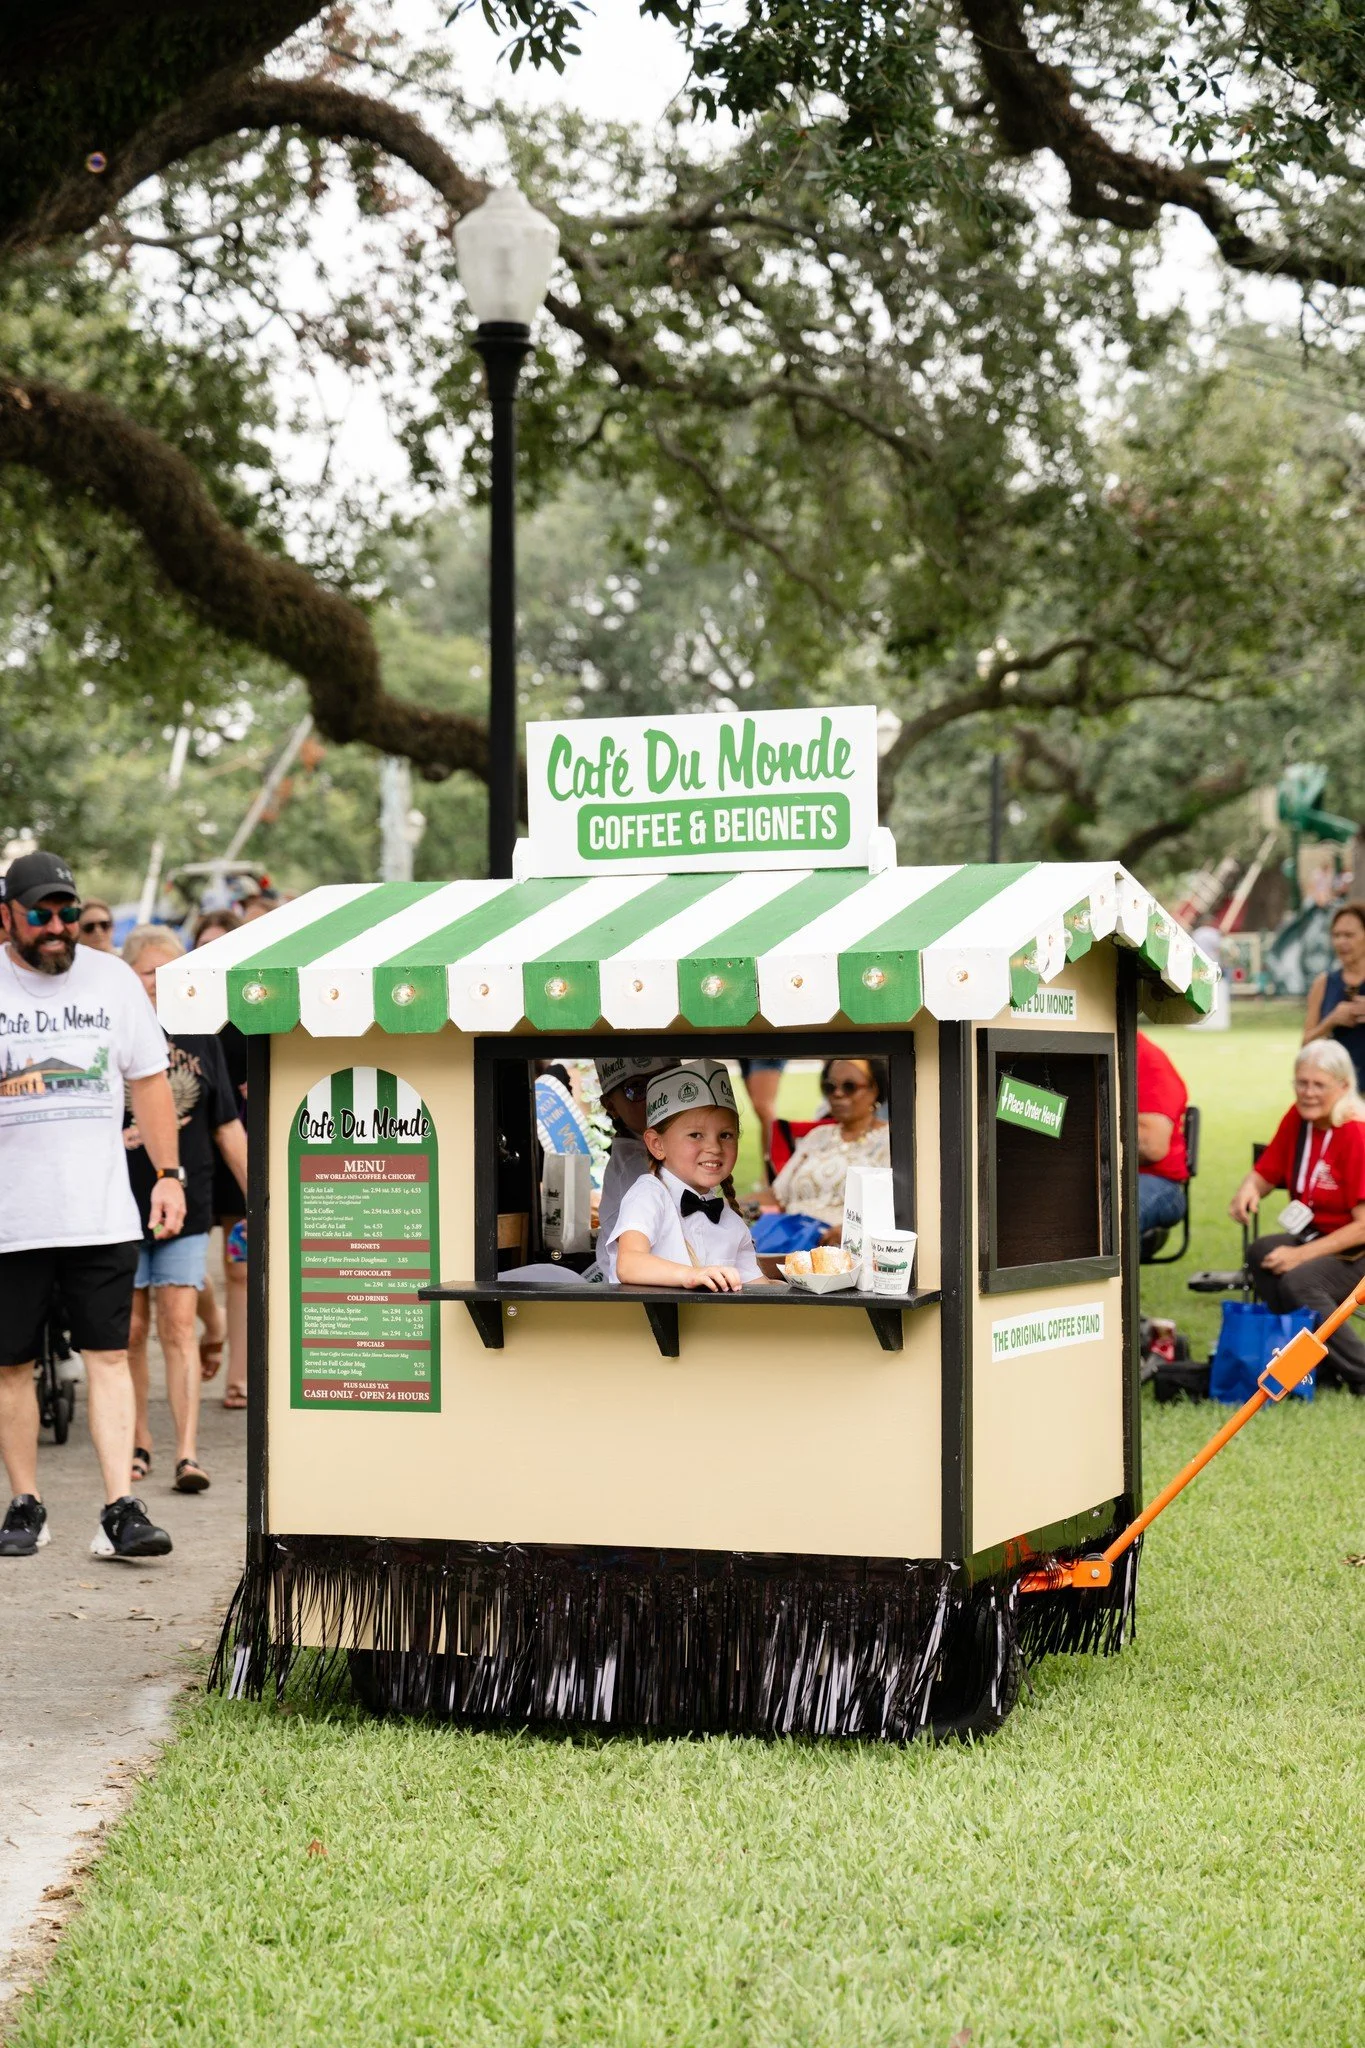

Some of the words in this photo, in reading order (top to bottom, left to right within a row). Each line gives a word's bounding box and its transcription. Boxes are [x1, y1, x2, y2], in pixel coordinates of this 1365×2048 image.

[548, 734, 634, 801] Café
[644, 728, 706, 794] Du
[718, 716, 855, 792] Monde
[589, 812, 682, 850] COFFEE
[690, 811, 706, 845] &
[714, 804, 838, 842] BEIGNETS
[36, 1010, 60, 1032] Du
[64, 1005, 111, 1031] Monde
[1034, 994, 1045, 1014] DU
[1047, 994, 1074, 1015] MONDE
[300, 1109, 337, 1139] Café
[341, 1109, 367, 1138] Du
[373, 1107, 430, 1139] Monde
[1006, 1092, 1024, 1115] Place
[1024, 1099, 1042, 1121] Order
[1041, 1104, 1056, 1127] Here
[344, 1160, 385, 1172] MENU
[993, 1330, 1008, 1352] THE
[1010, 1323, 1046, 1349] ORIGINAL
[1048, 1317, 1075, 1340] COFFEE
[1077, 1314, 1100, 1335] STAND
[304, 1390, 328, 1398] CASH
[330, 1390, 354, 1398] ONLY
[360, 1391, 385, 1399] OPEN
[398, 1392, 429, 1400] HOURS
